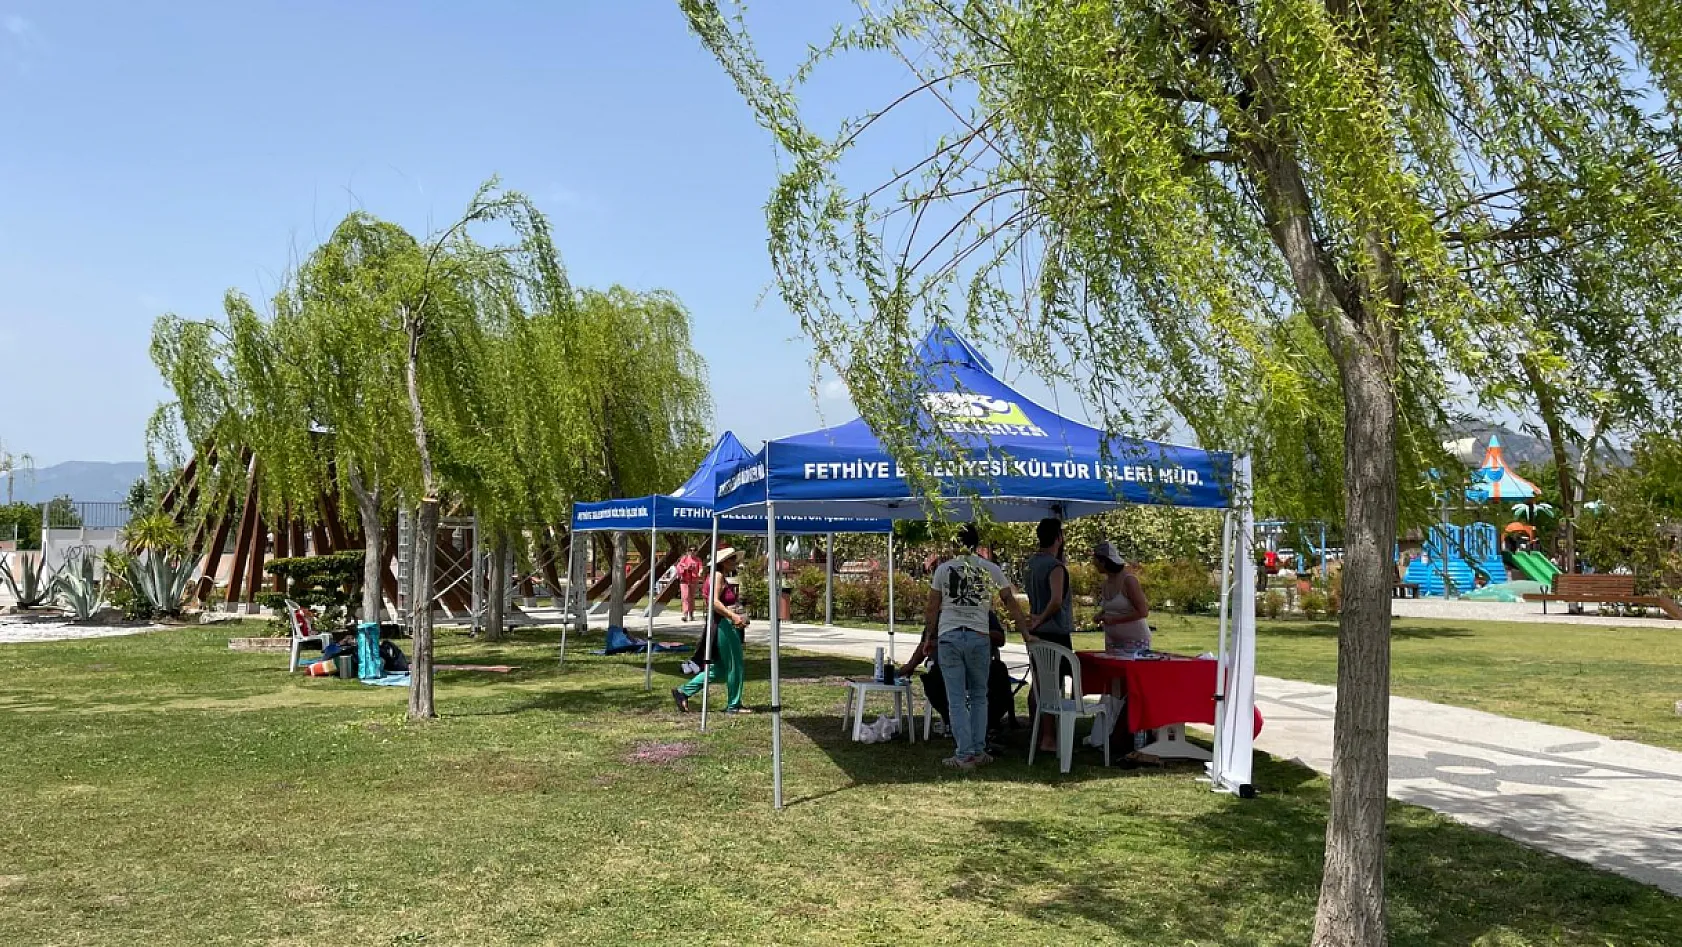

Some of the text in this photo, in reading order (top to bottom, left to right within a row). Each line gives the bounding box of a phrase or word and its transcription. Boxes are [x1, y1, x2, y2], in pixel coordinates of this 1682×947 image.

[804, 458, 890, 479] FETHİYE
[1014, 457, 1090, 480] KÜLTÜR
[1095, 460, 1154, 484] İŞLERİ
[1160, 465, 1204, 487] MÜD.
